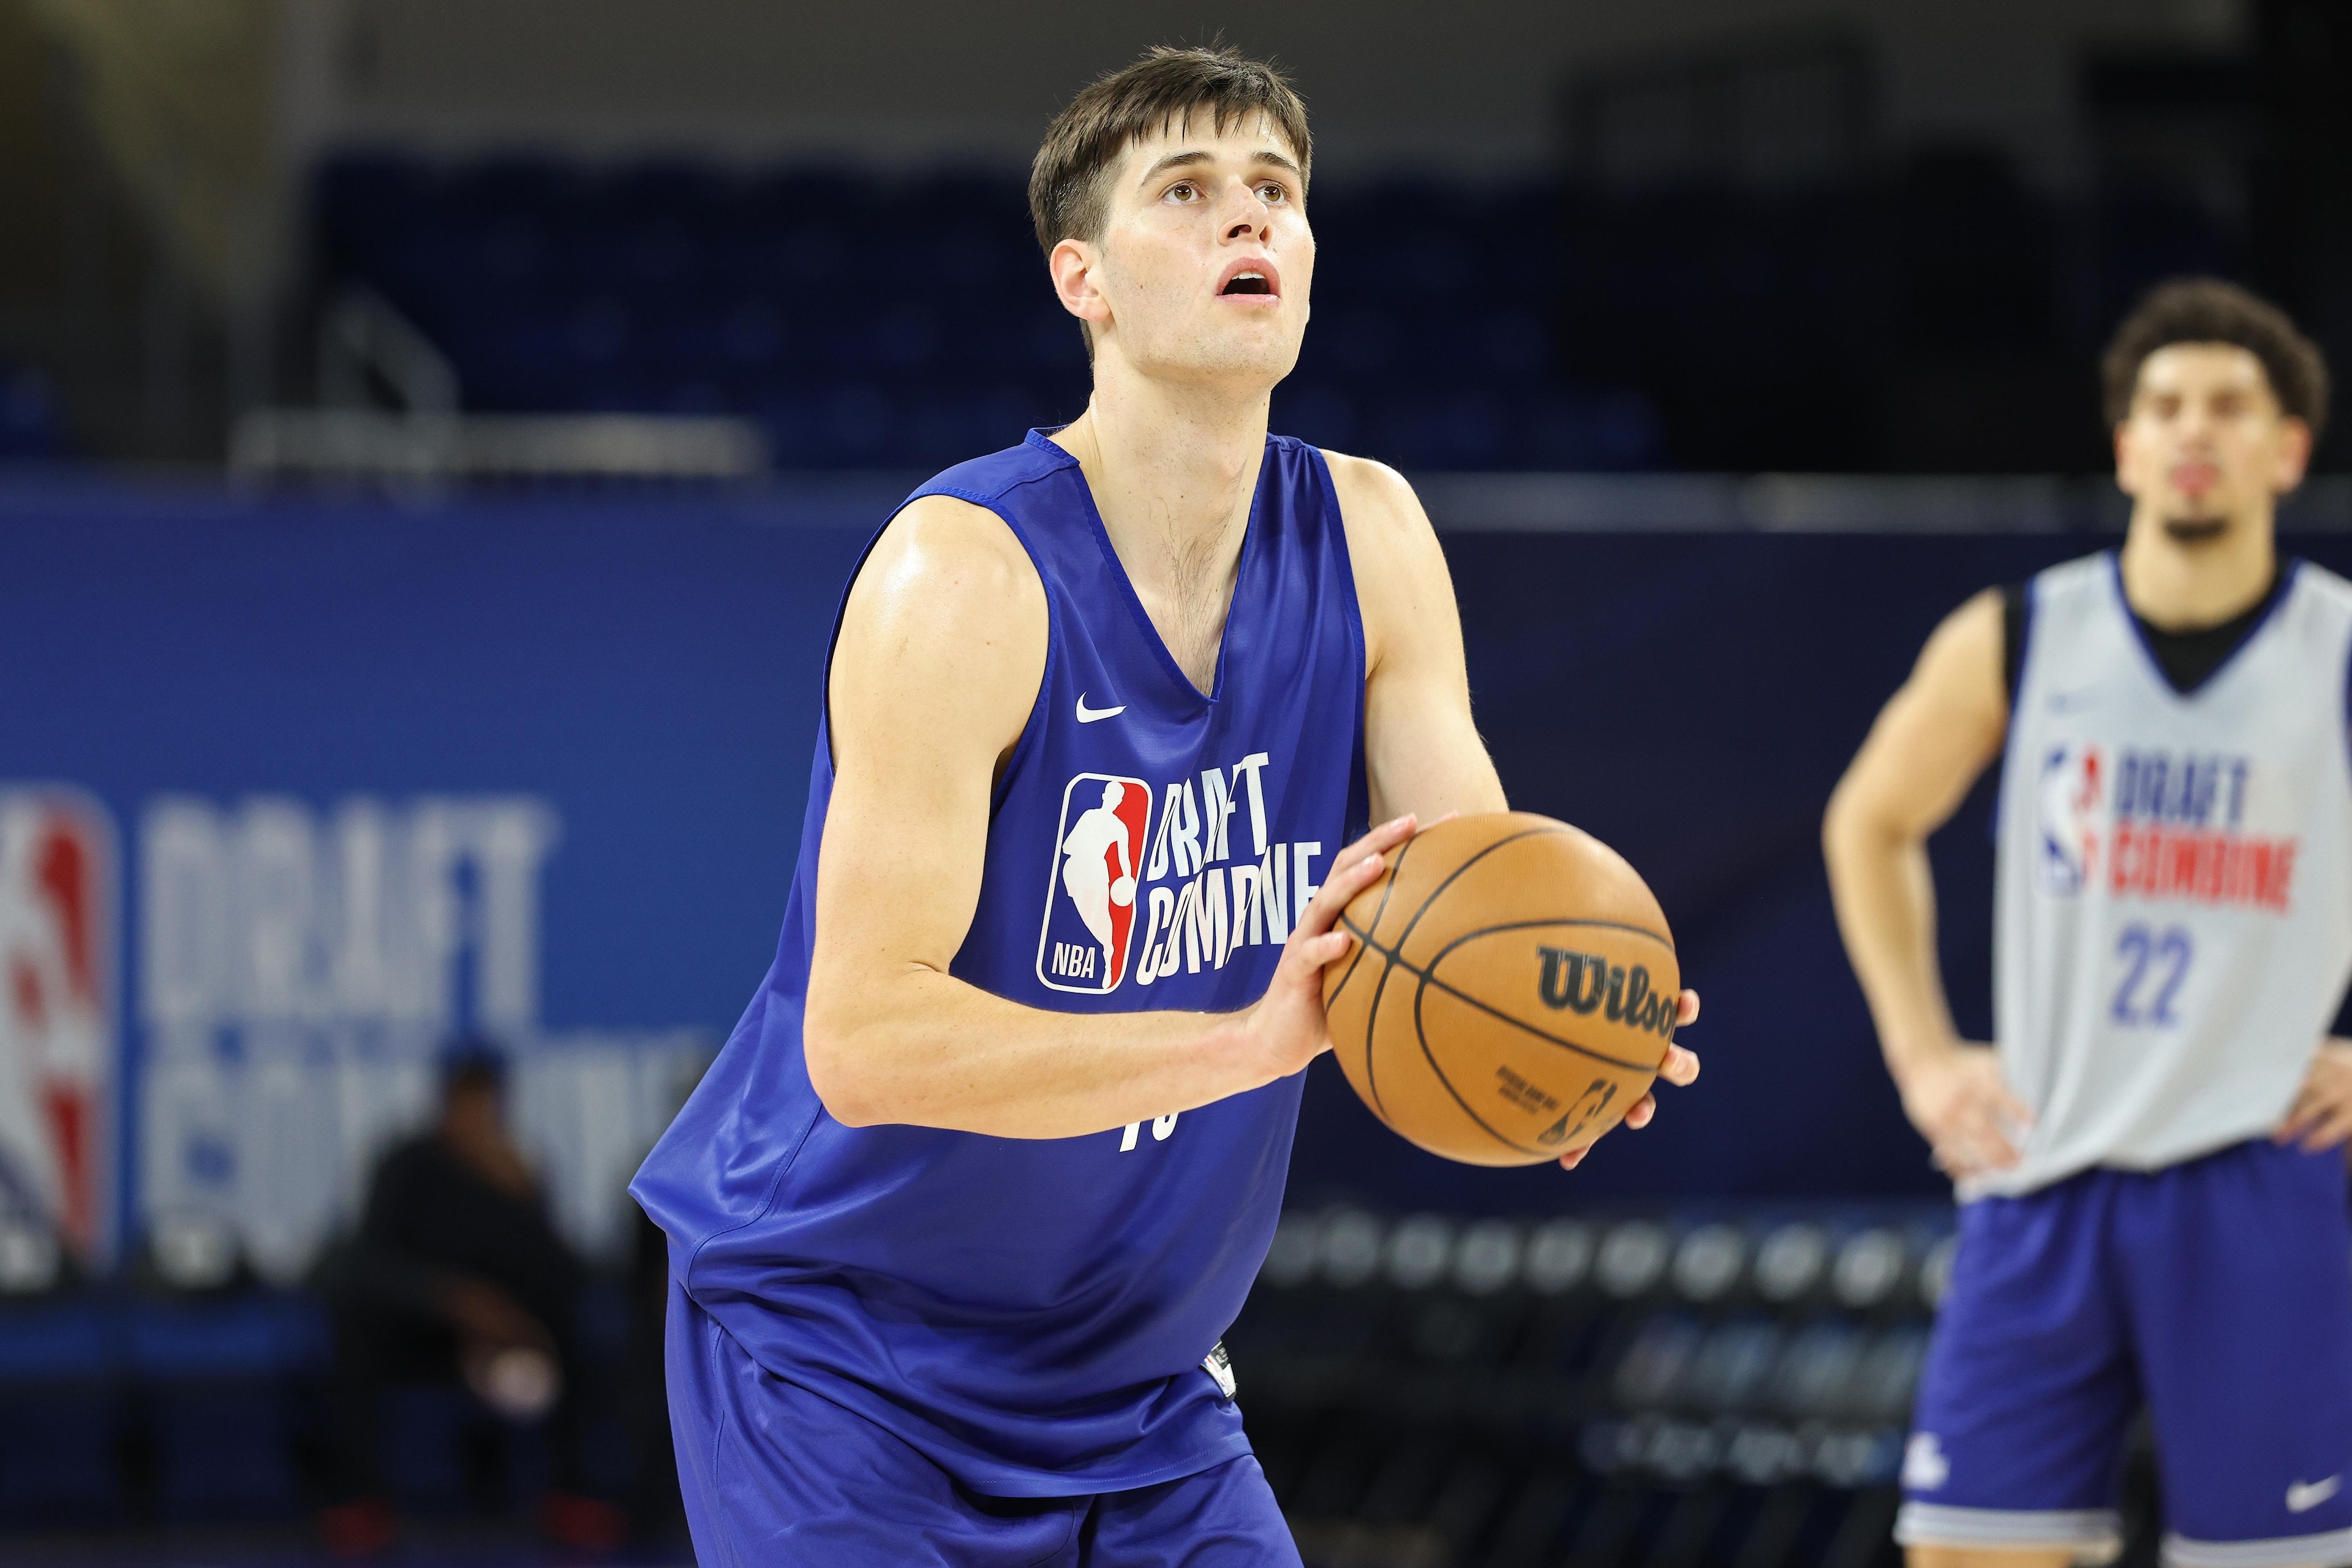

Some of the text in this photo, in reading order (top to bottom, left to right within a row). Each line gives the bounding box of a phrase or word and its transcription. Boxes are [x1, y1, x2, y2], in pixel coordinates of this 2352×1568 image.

[1146, 752, 1270, 882] DRAFT
[1051, 941, 1096, 979] NBA
[1536, 946, 1678, 1042] Wilso
[2111, 923, 2194, 1027] 22
